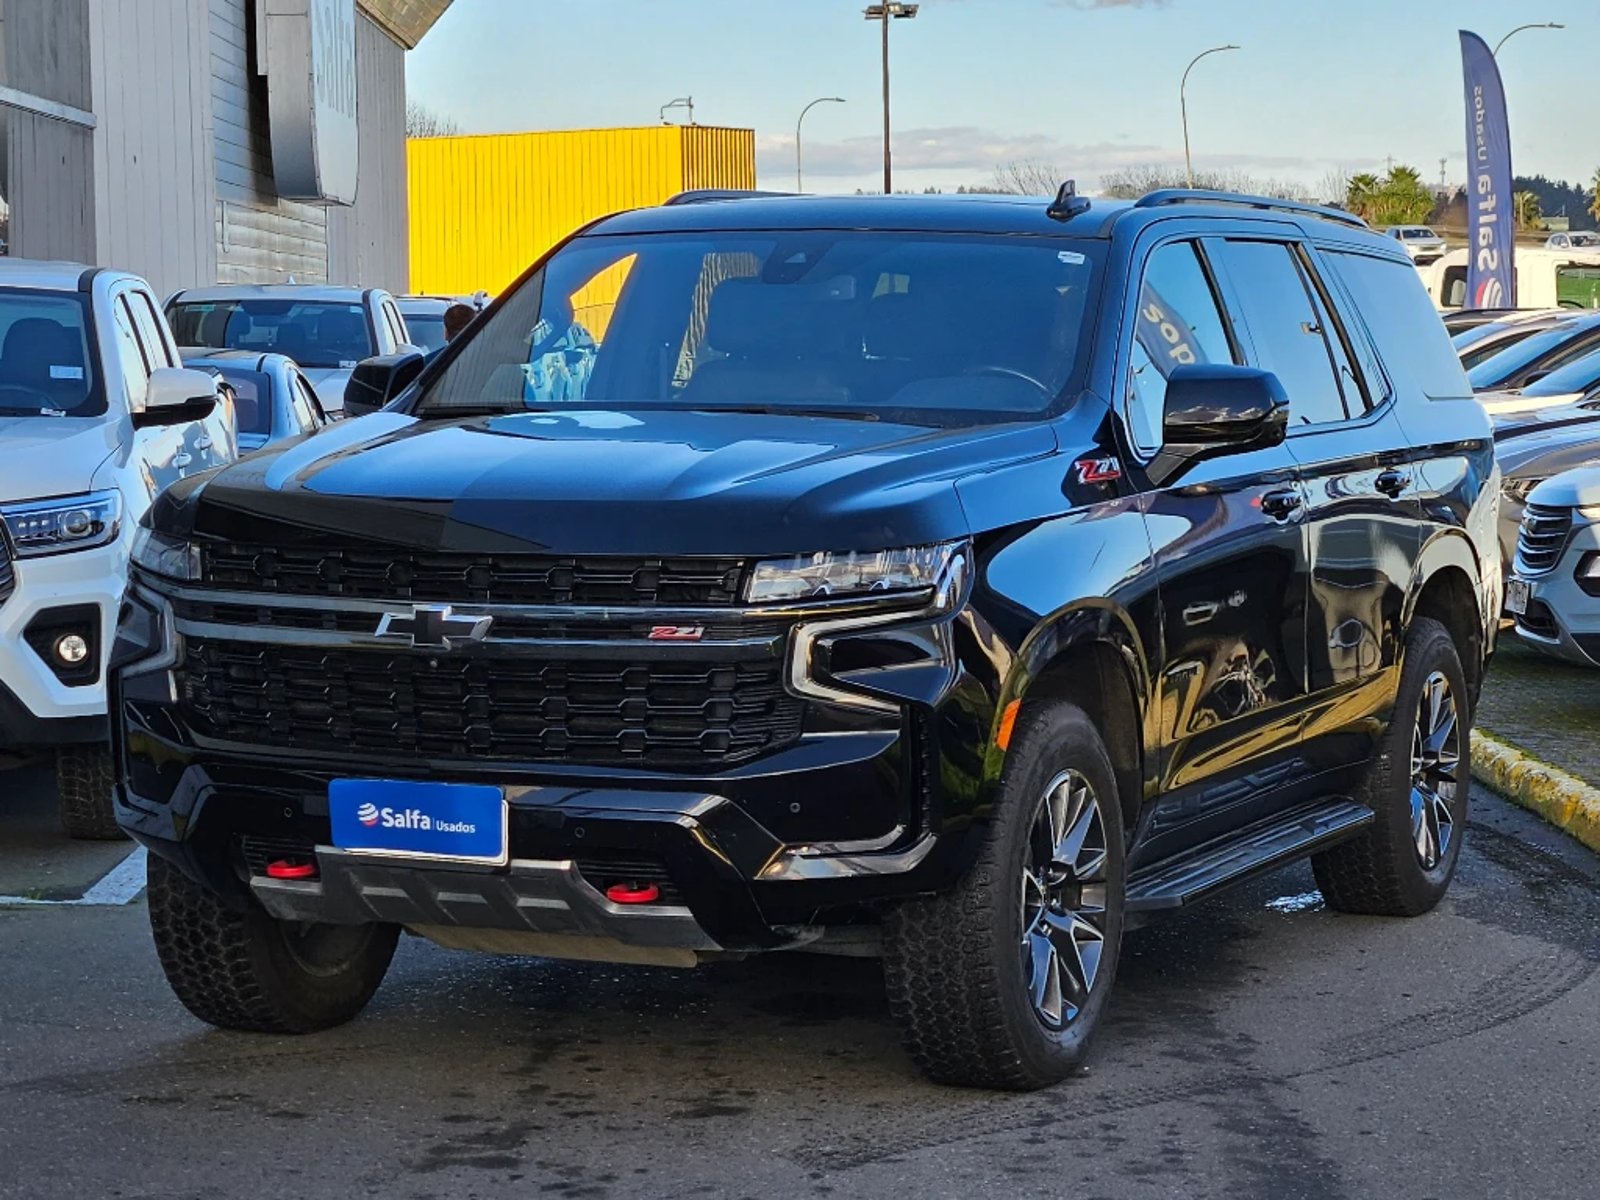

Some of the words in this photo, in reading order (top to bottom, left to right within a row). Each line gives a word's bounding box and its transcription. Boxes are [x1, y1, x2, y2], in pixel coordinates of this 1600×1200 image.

[1074, 456, 1121, 484] Z71
[381, 807, 431, 831] Salfa
[436, 820, 476, 834] Usados
